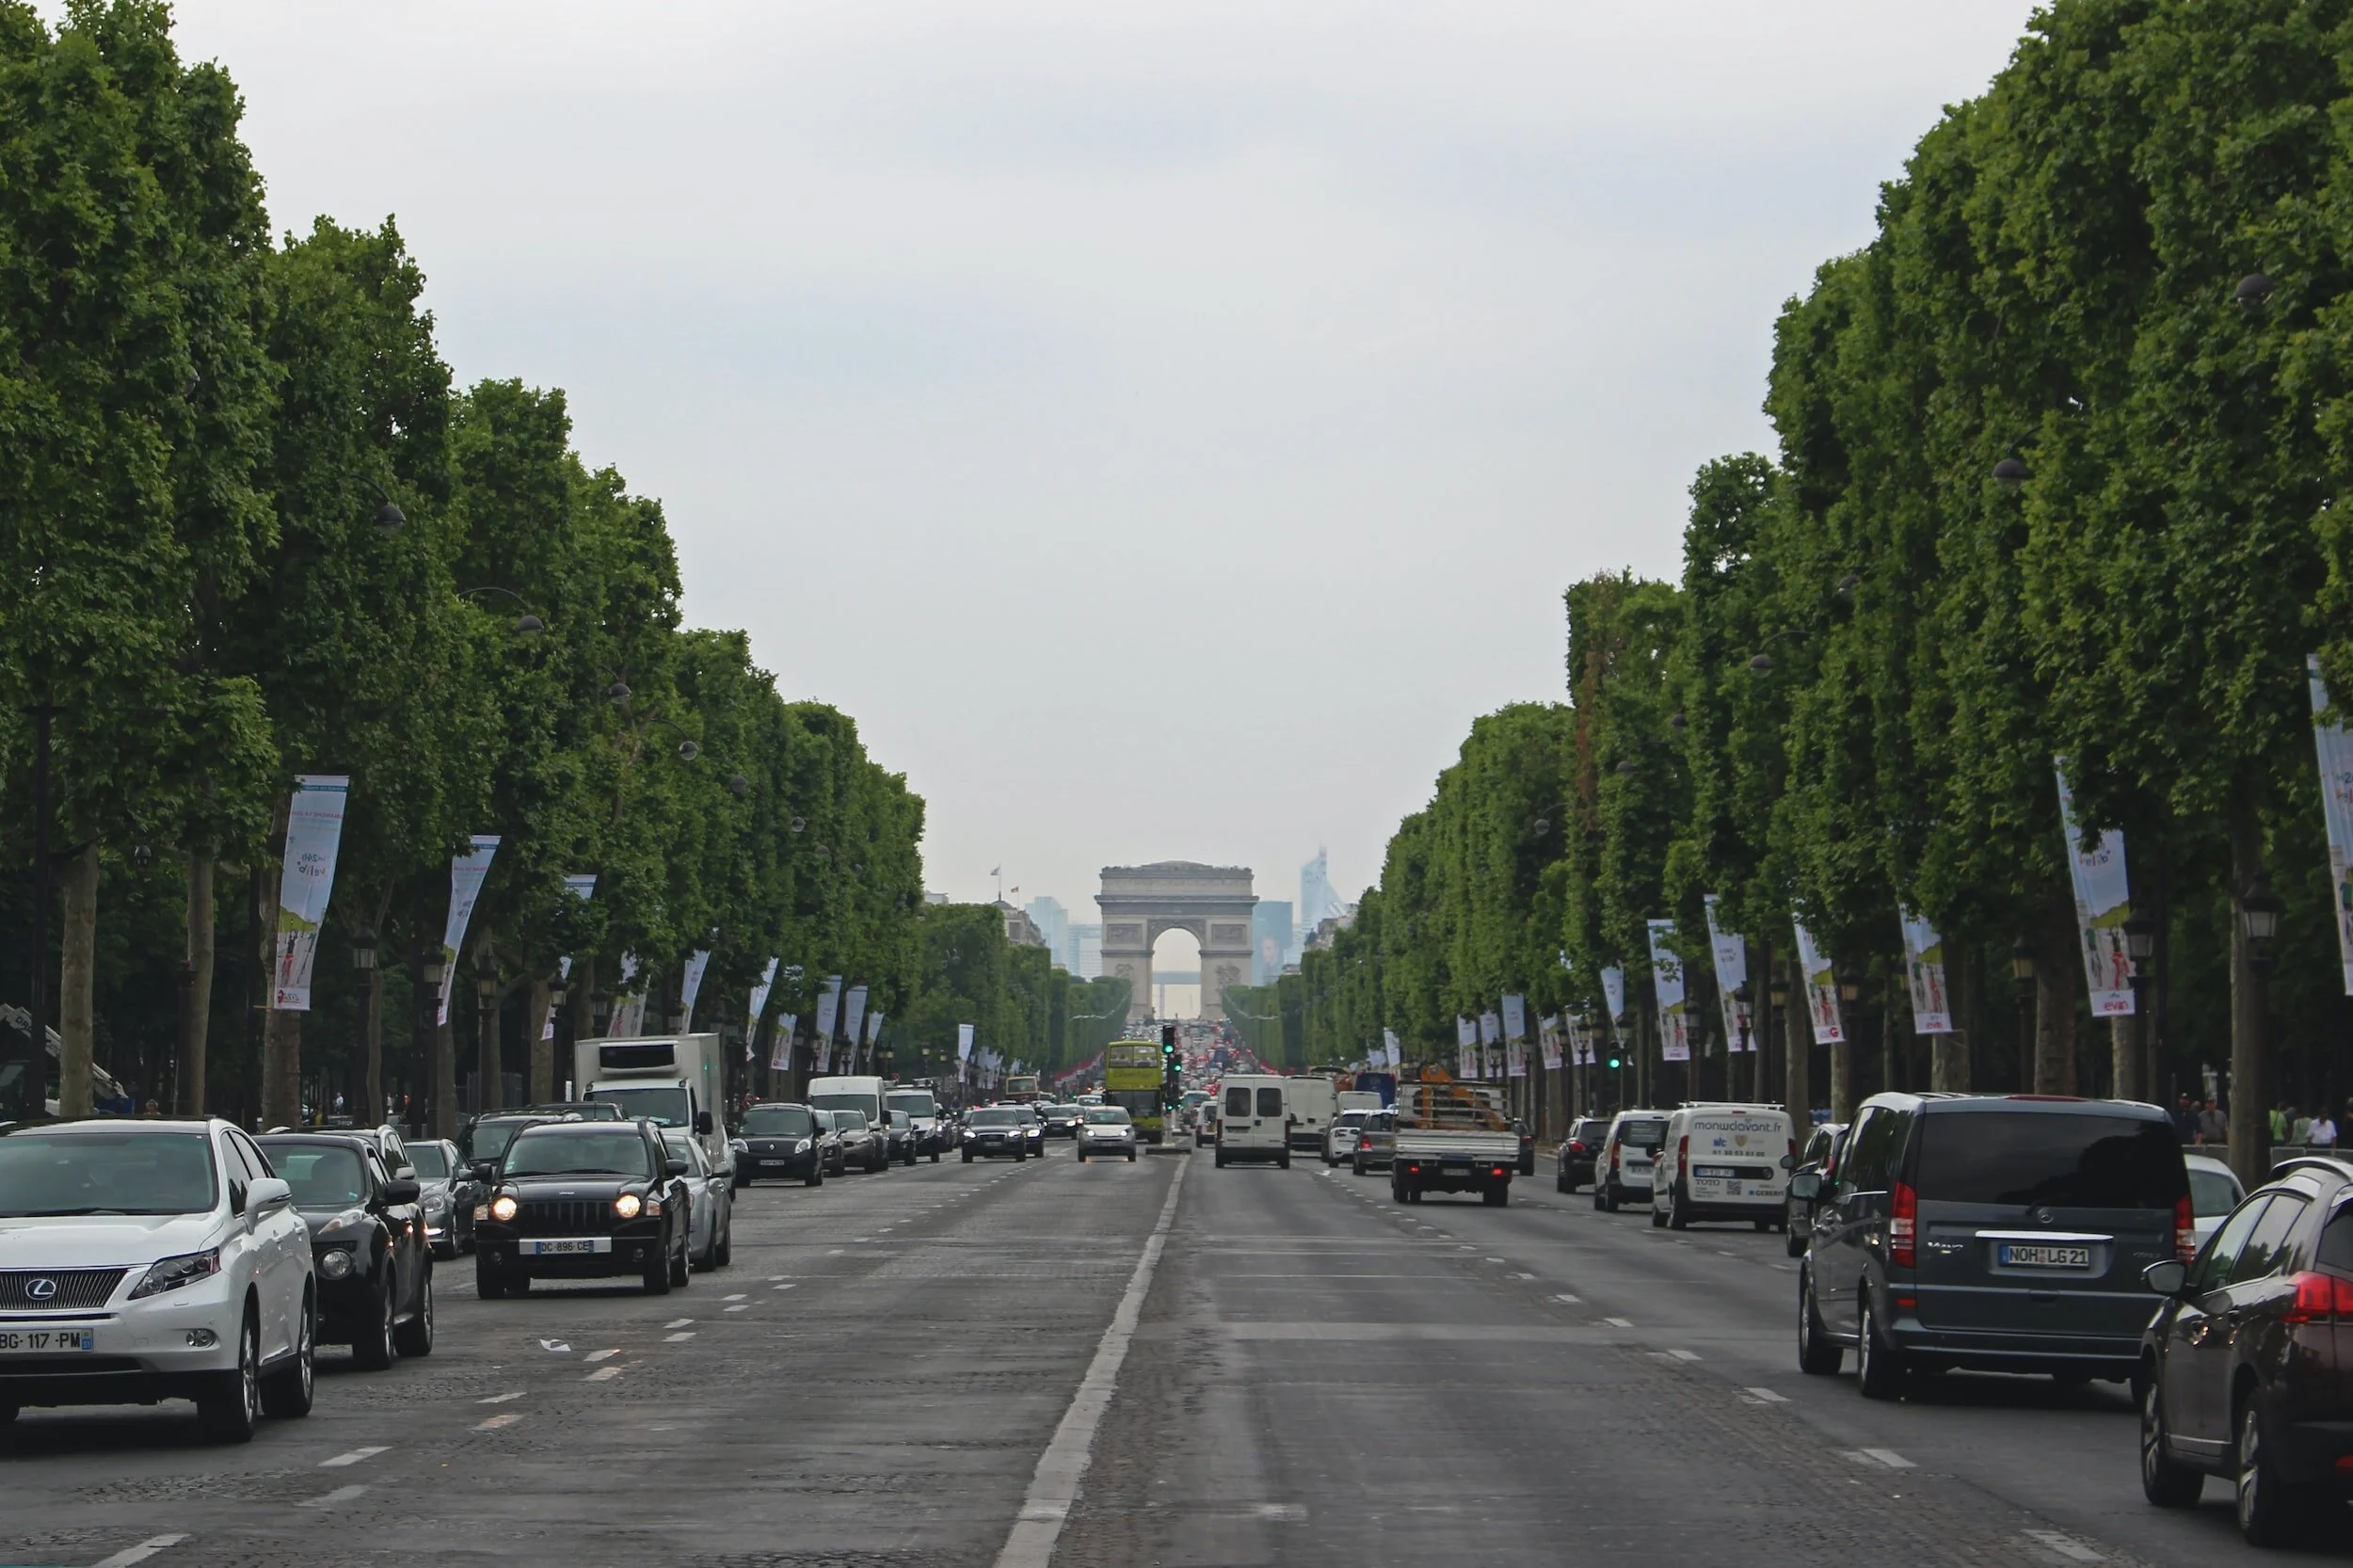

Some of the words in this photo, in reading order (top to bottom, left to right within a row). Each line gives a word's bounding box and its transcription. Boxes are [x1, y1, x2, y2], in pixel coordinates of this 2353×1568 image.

[2009, 1248, 2038, 1261] NOH
[2048, 1249, 2067, 1263] LG
[2070, 1250, 2088, 1264] 21
